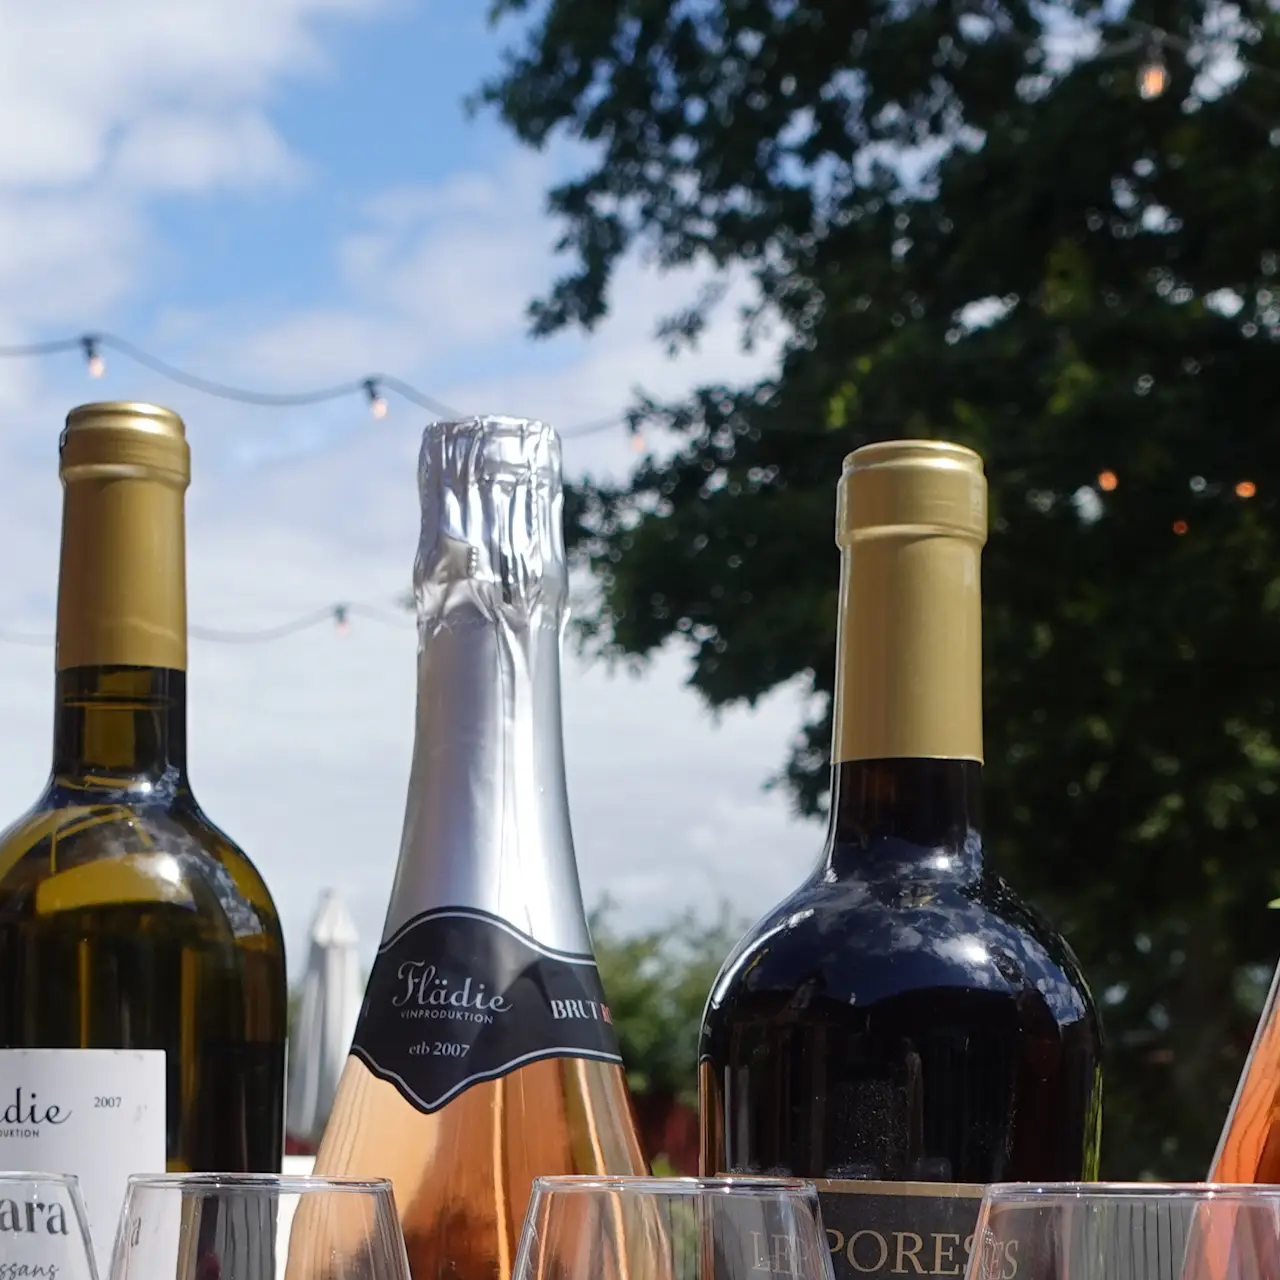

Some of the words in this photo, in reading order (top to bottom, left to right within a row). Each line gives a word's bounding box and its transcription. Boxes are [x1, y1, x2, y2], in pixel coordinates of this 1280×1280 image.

[393, 960, 514, 1013] Flädie
[400, 1010, 494, 1025] VINPRODUKTION
[551, 999, 598, 1020] BRUT
[433, 1041, 470, 1058] 2007
[93, 1096, 123, 1109] 2007
